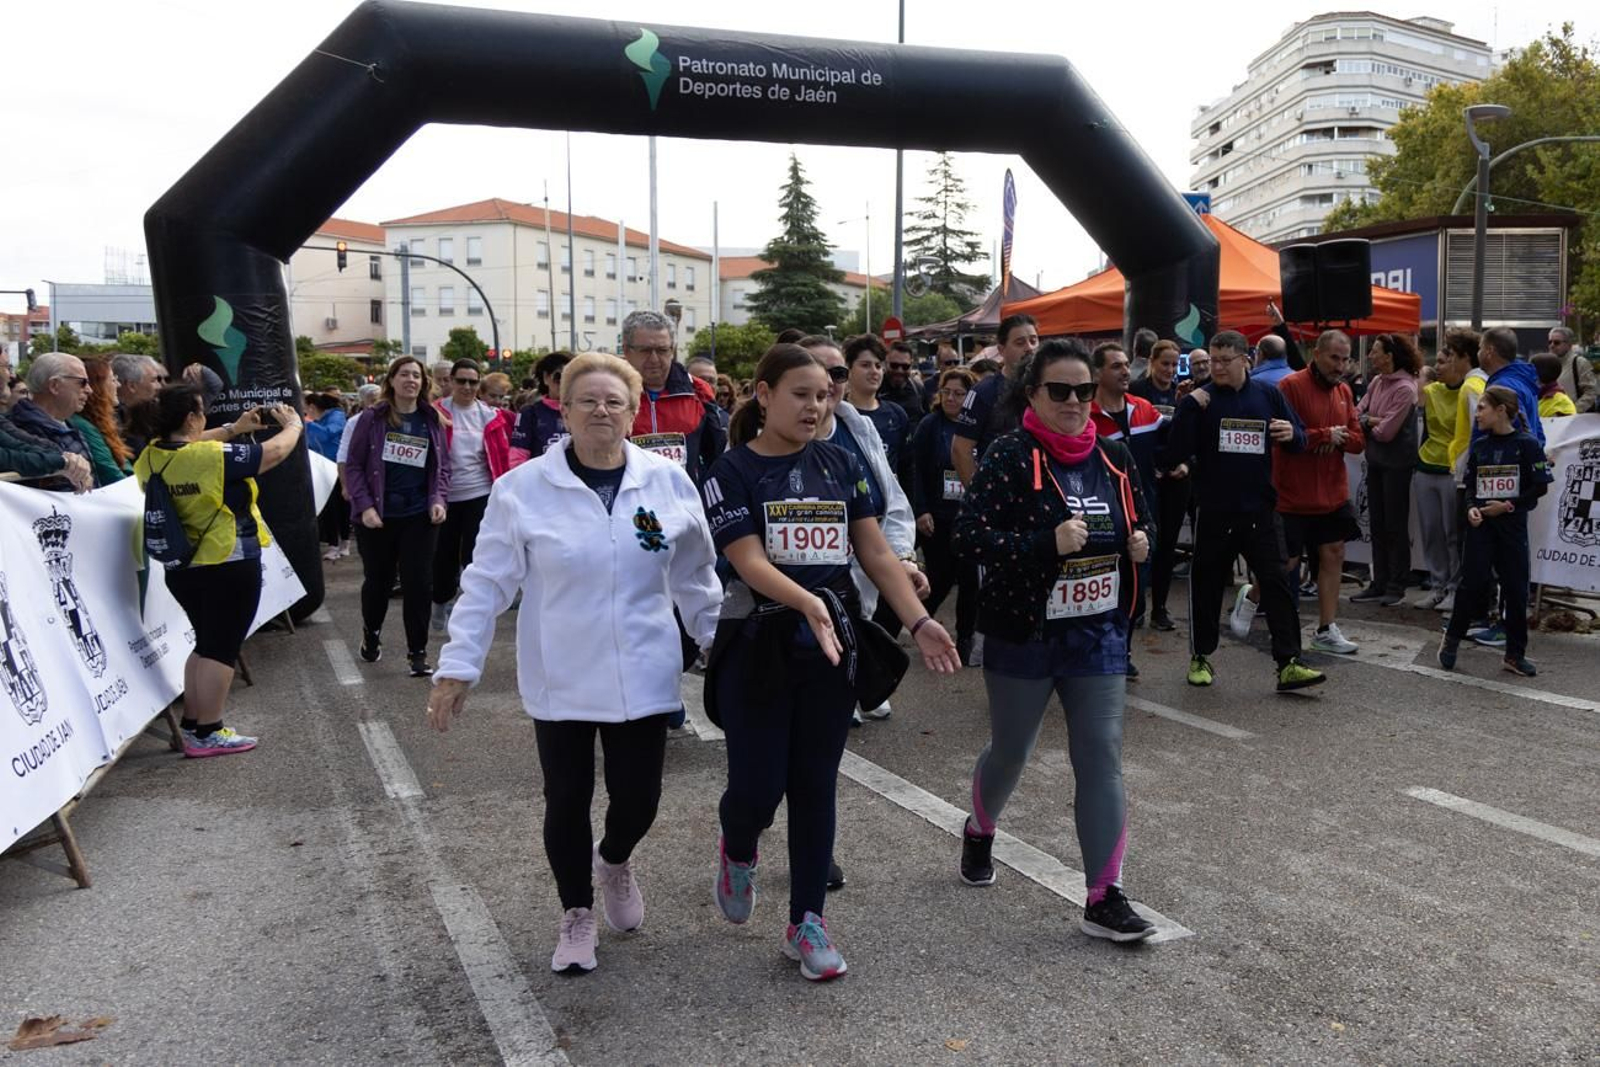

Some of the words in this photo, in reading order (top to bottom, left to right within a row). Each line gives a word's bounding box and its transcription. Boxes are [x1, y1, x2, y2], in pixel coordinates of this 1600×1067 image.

[678, 56, 767, 77] Patronato
[772, 63, 856, 86] Municipal
[861, 70, 882, 86] de
[679, 77, 763, 99] Deportes
[768, 84, 790, 100] de
[795, 85, 837, 103] Jaén
[229, 386, 281, 399] Municipal
[282, 387, 292, 397] de
[210, 403, 240, 413] ortes
[242, 400, 257, 410] de
[1226, 432, 1260, 446] 1898
[390, 444, 423, 460] 1067
[1482, 478, 1515, 492] 1160
[769, 504, 788, 516] XXV
[1066, 496, 1110, 514] 25
[777, 526, 839, 550] 1902
[1536, 549, 1578, 564] CIUDAD
[1579, 554, 1597, 567] DE
[1057, 576, 1112, 604] 1895
[11, 738, 51, 778] CIUDAD
